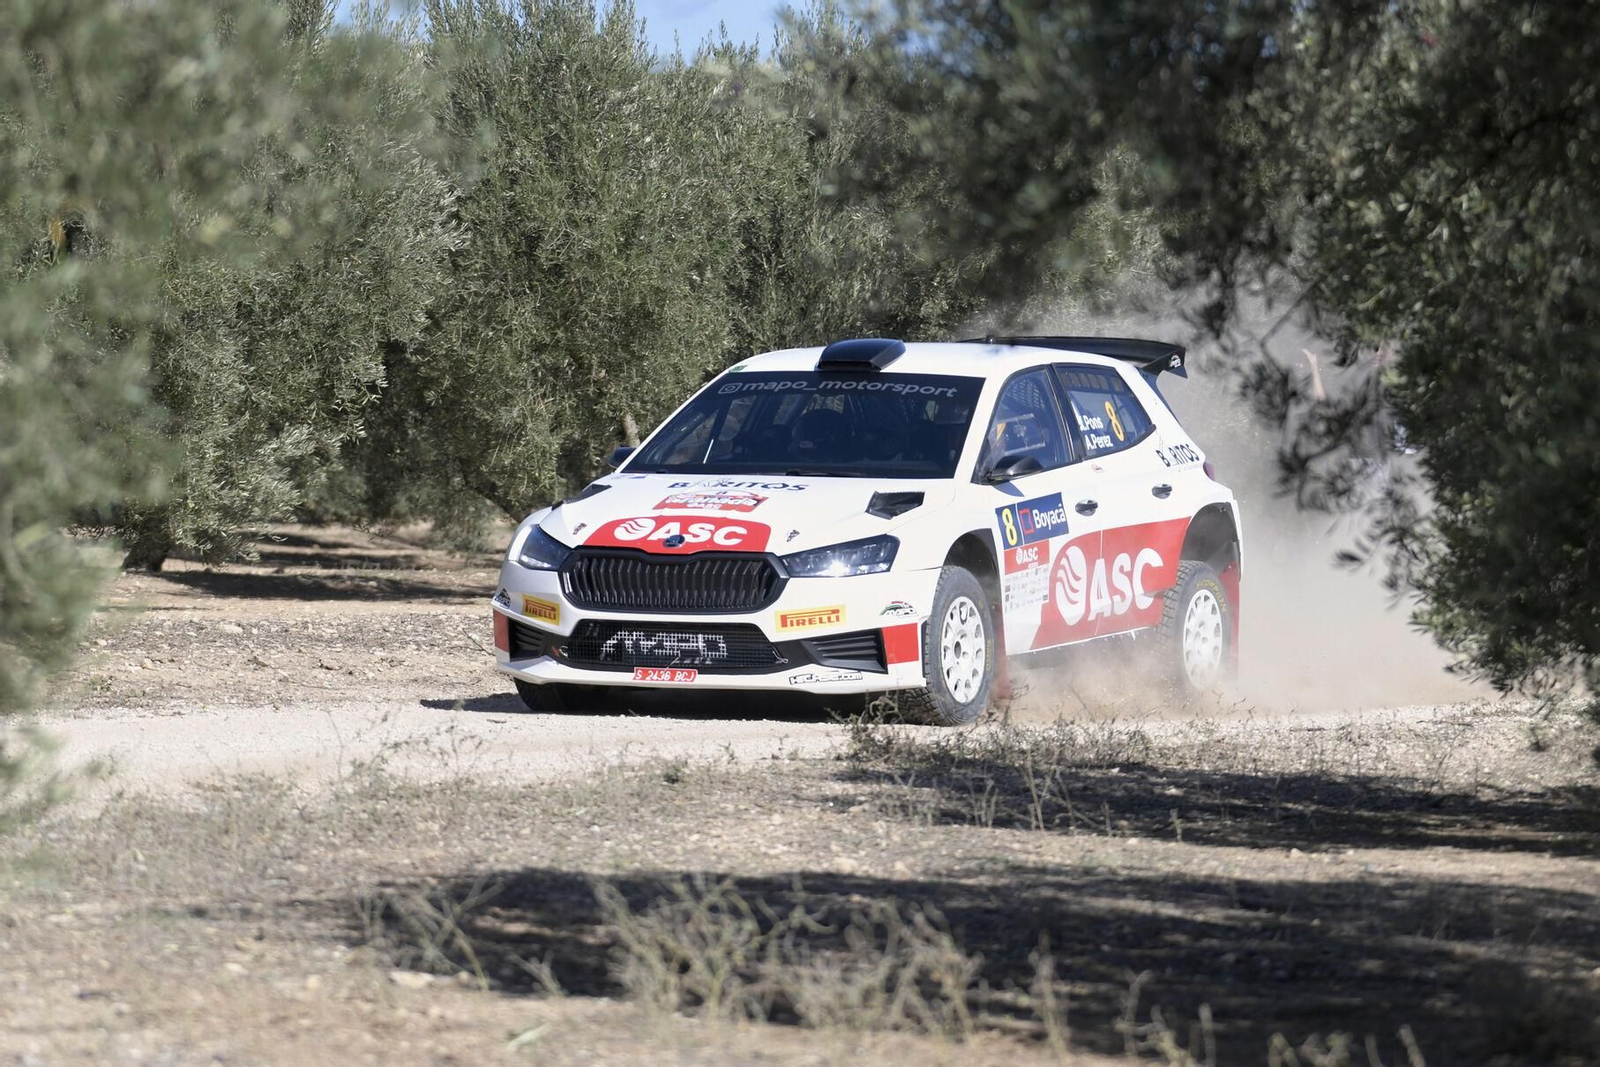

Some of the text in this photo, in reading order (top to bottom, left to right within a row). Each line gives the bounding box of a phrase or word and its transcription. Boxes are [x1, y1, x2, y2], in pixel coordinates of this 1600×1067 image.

[1104, 401, 1125, 442] 8
[1085, 433, 1114, 450] A.Perez
[1001, 508, 1018, 546] 8
[1033, 504, 1066, 530] Boyacá
[646, 521, 748, 545] ASC
[1022, 546, 1039, 563] ASC
[1087, 548, 1164, 621] ASC
[525, 599, 557, 621] PIRELLI
[780, 608, 840, 629] PIRELLI
[635, 670, 695, 682] S 2436 BCJ
